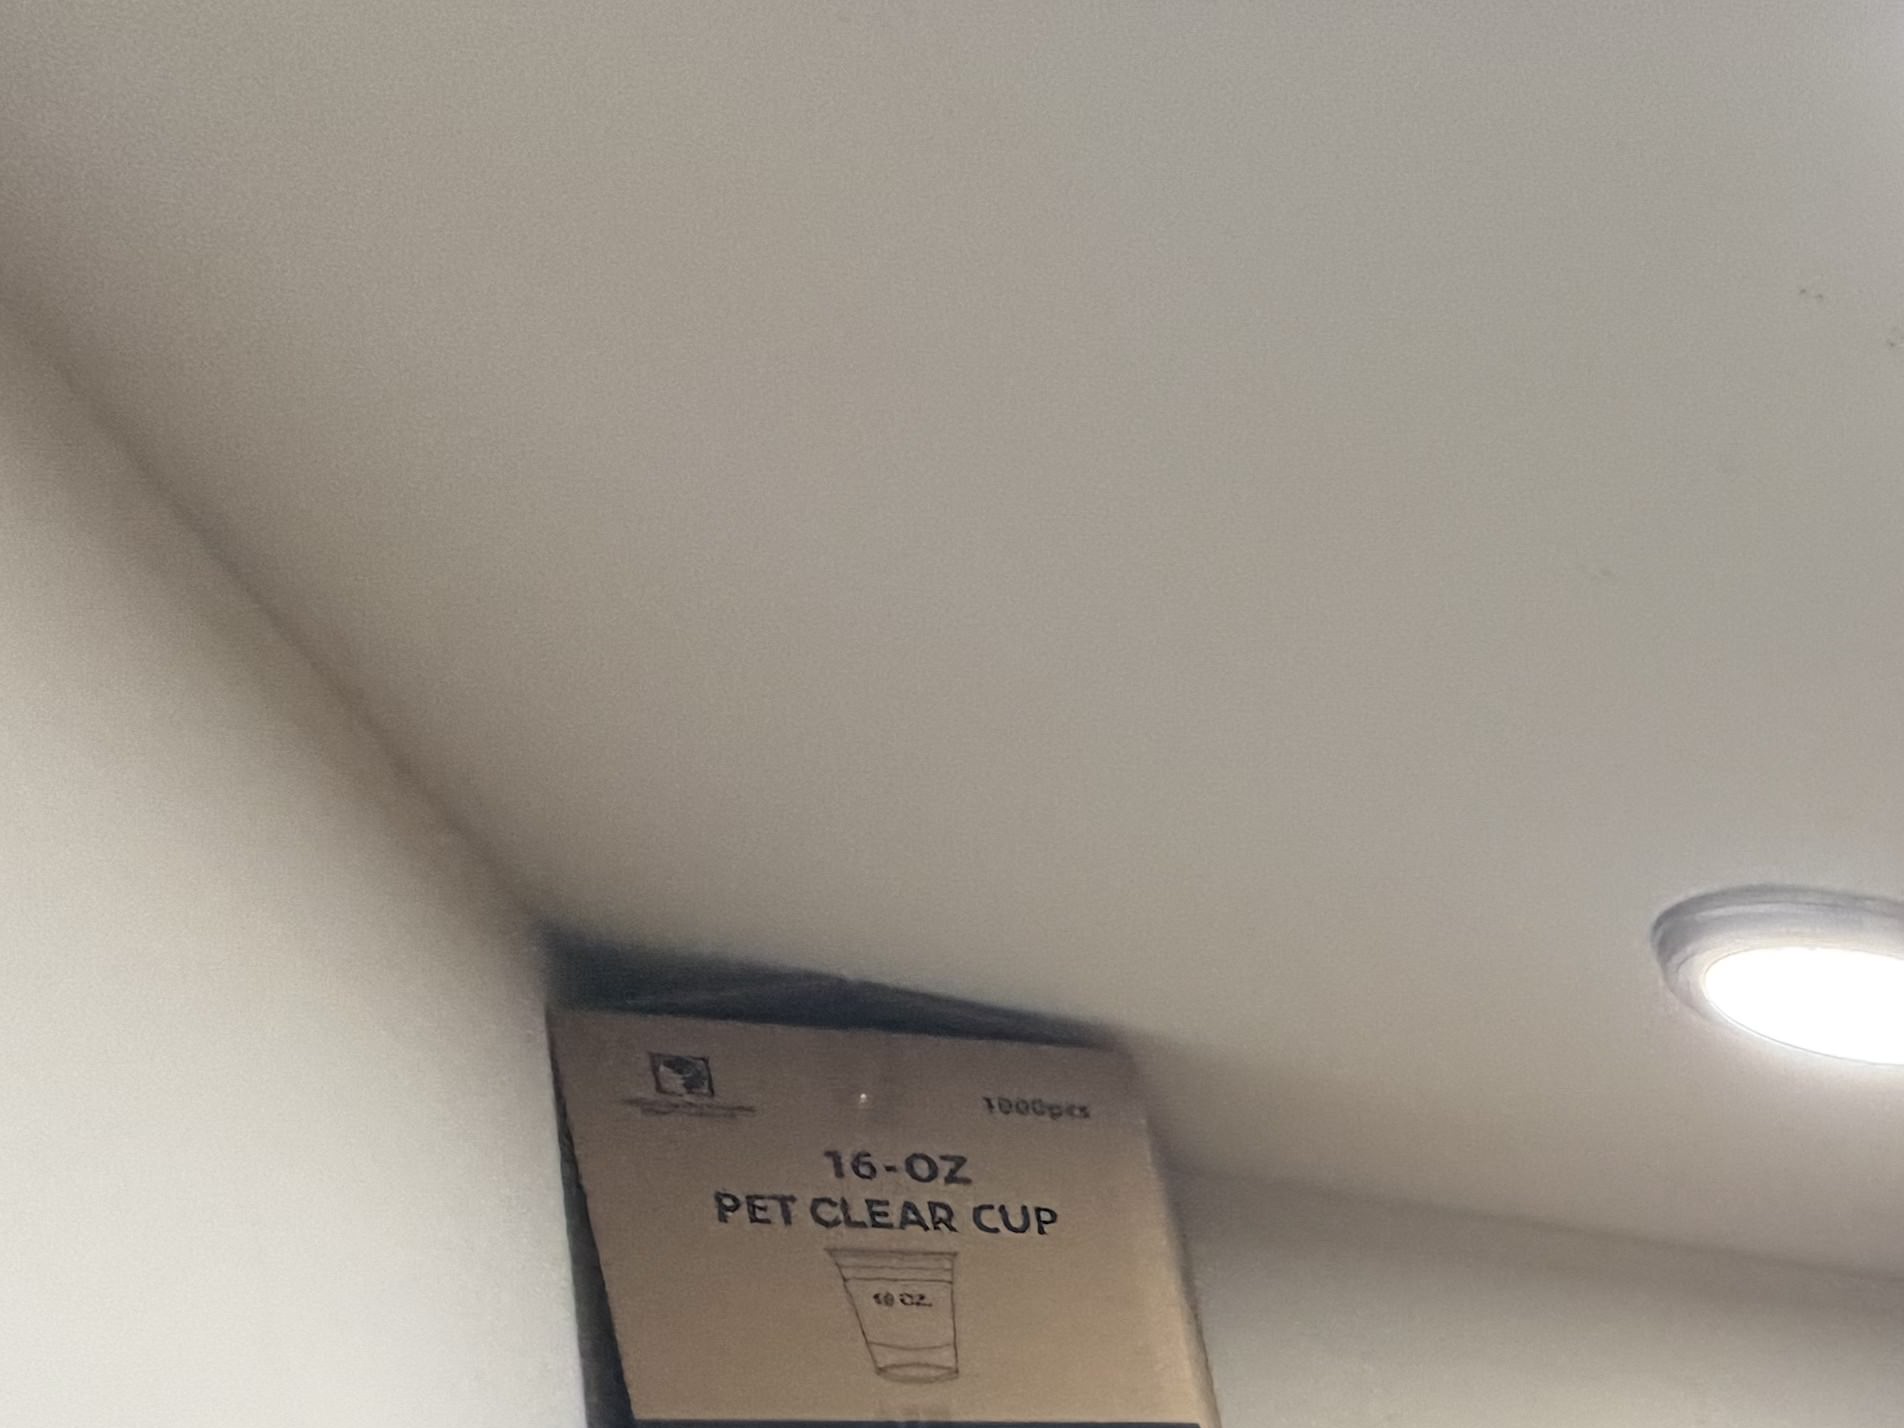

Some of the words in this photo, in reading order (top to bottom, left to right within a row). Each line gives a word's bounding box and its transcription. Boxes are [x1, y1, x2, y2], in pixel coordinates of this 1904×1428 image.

[824, 1150, 972, 1186] 16-OZ
[714, 1192, 797, 1227] PET
[811, 1197, 957, 1233] CLEAR
[973, 1204, 1058, 1237] CUP
